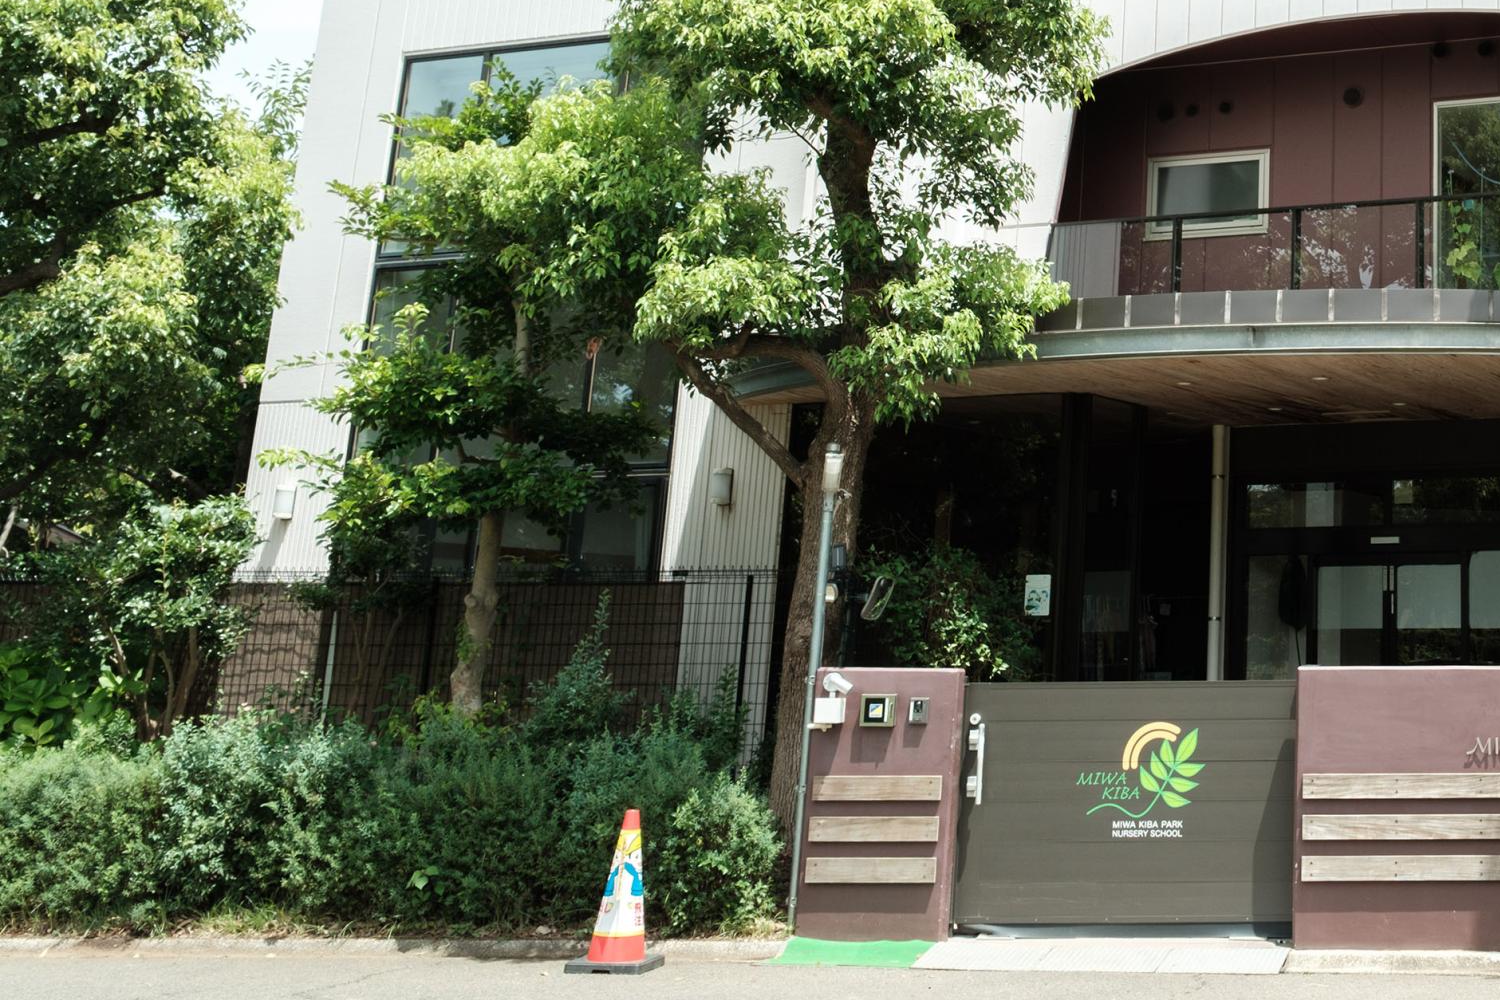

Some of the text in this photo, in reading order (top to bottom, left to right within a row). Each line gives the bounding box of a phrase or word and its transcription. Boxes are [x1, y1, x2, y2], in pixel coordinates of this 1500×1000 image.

[1076, 772, 1127, 785] MIWA
[1102, 786, 1140, 800] KIBA
[1112, 820, 1183, 829] MIWA KIBA PARK
[1112, 830, 1183, 838] NURSERY SCHOOL
